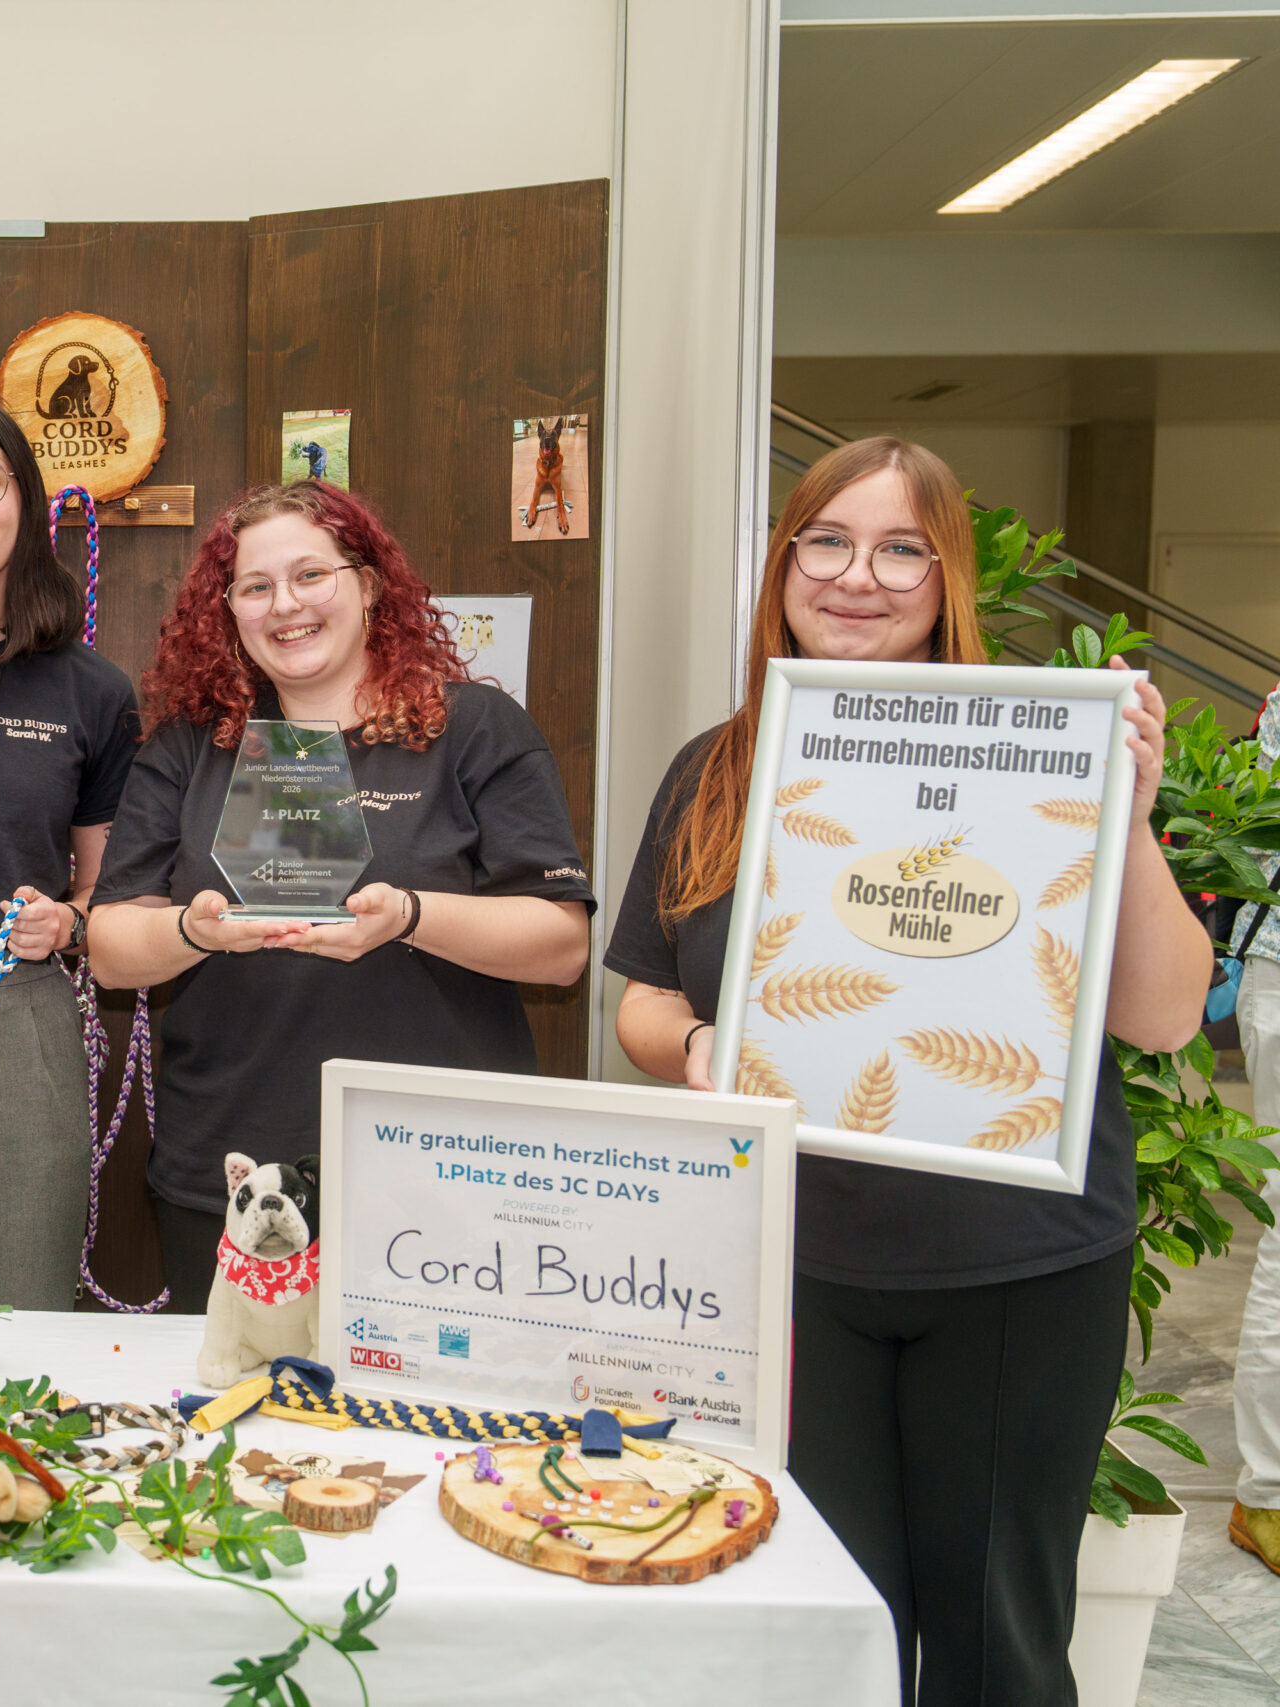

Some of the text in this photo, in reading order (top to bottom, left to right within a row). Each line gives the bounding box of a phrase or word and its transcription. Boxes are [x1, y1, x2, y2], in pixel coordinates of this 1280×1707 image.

[43, 420, 113, 440] CORD
[31, 438, 127, 459] BUDDYS
[52, 459, 107, 470] LEASHES
[832, 692, 1069, 731] Gutschein für eine
[24, 719, 68, 734] BUDDYS
[6, 728, 52, 742] Sarah W.
[801, 732, 1093, 779] Unternehmensführung
[244, 763, 340, 773] Junior Landeswettbewerb
[261, 773, 322, 783] Niederösterreich
[282, 785, 302, 793] 2026
[372, 790, 422, 801] BUDDYS
[916, 782, 958, 811] bei
[360, 799, 392, 811] Magi
[262, 809, 321, 821] 1. PLATZ
[277, 860, 305, 868] Junior
[277, 868, 332, 877] Achievement
[277, 876, 308, 884] Austria
[847, 873, 1004, 917] Rosenfellner
[888, 912, 953, 943] Mühle
[375, 1124, 731, 1180] Wir gratulieren herzlichst zum
[435, 1161, 660, 1204] 1.Platz des JC DAYs
[502, 1198, 560, 1215] POWERED
[493, 1212, 593, 1231] MILLENNIUM CITY
[386, 1229, 721, 1331] Cord Buddys
[367, 1323, 379, 1332] JA
[368, 1332, 398, 1343] Austria
[351, 1348, 400, 1369] WKO
[568, 1352, 695, 1379] MILLENNIUM CITY
[594, 1385, 633, 1399] UniCredit
[594, 1396, 641, 1411] Foundation
[668, 1391, 741, 1414] Bank Austria
[703, 1413, 741, 1426] UniCredit
